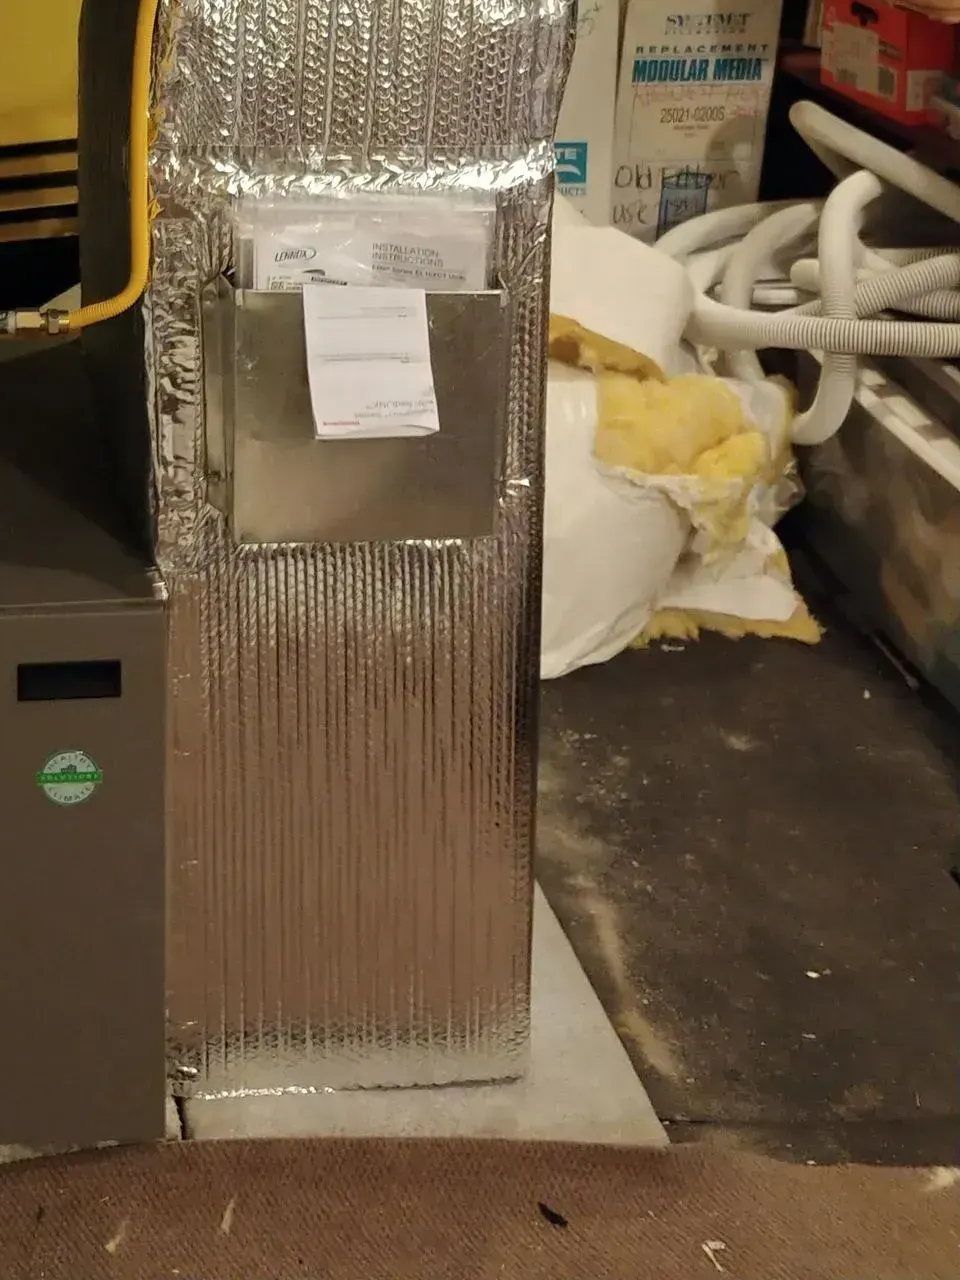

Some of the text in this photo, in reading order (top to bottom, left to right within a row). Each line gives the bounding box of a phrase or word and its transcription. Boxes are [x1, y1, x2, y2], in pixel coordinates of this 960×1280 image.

[635, 43, 769, 54] REPLACEMENT
[632, 58, 709, 83] MODULAR
[713, 57, 762, 81] MEDIA
[274, 249, 308, 263] LENNOX
[372, 242, 439, 258] INSTALLATION
[372, 252, 444, 268] INSTRUCTIONS
